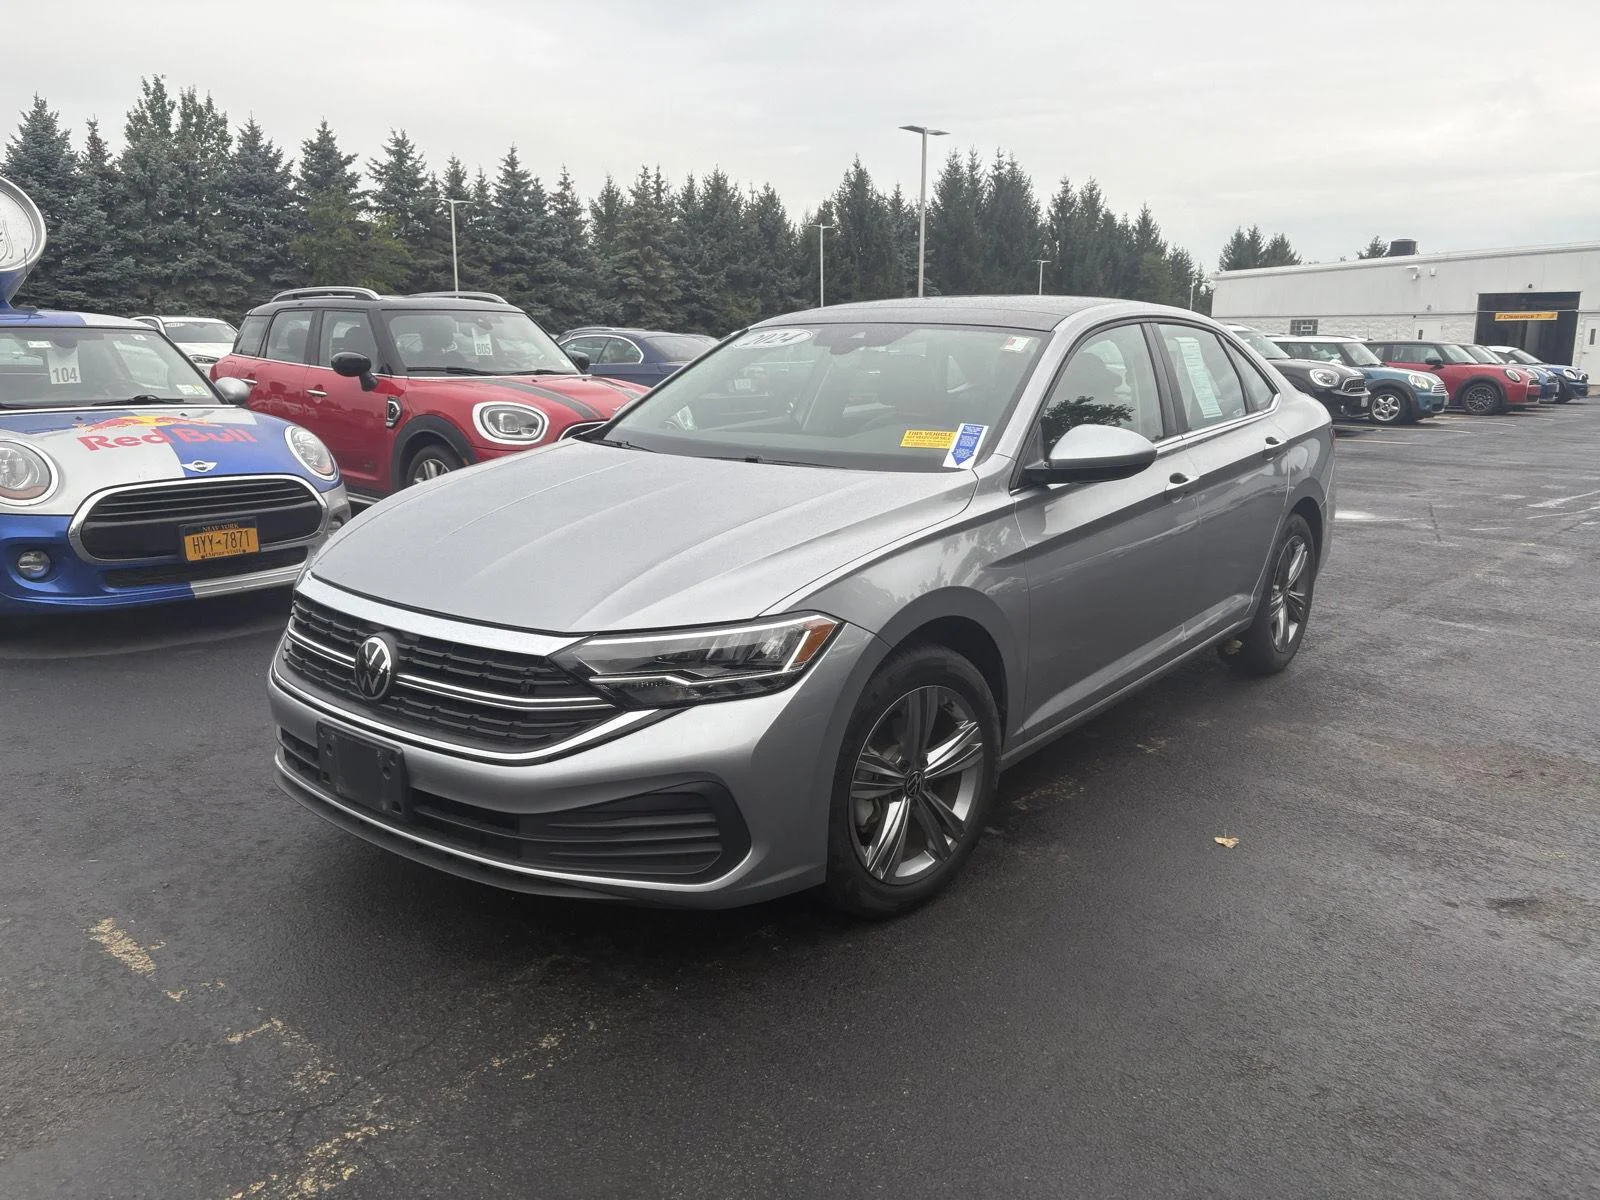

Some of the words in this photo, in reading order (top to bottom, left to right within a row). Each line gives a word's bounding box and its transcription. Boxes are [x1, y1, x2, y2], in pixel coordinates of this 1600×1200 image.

[52, 367, 78, 384] 104
[77, 427, 173, 452] Red
[170, 427, 257, 444] Bull
